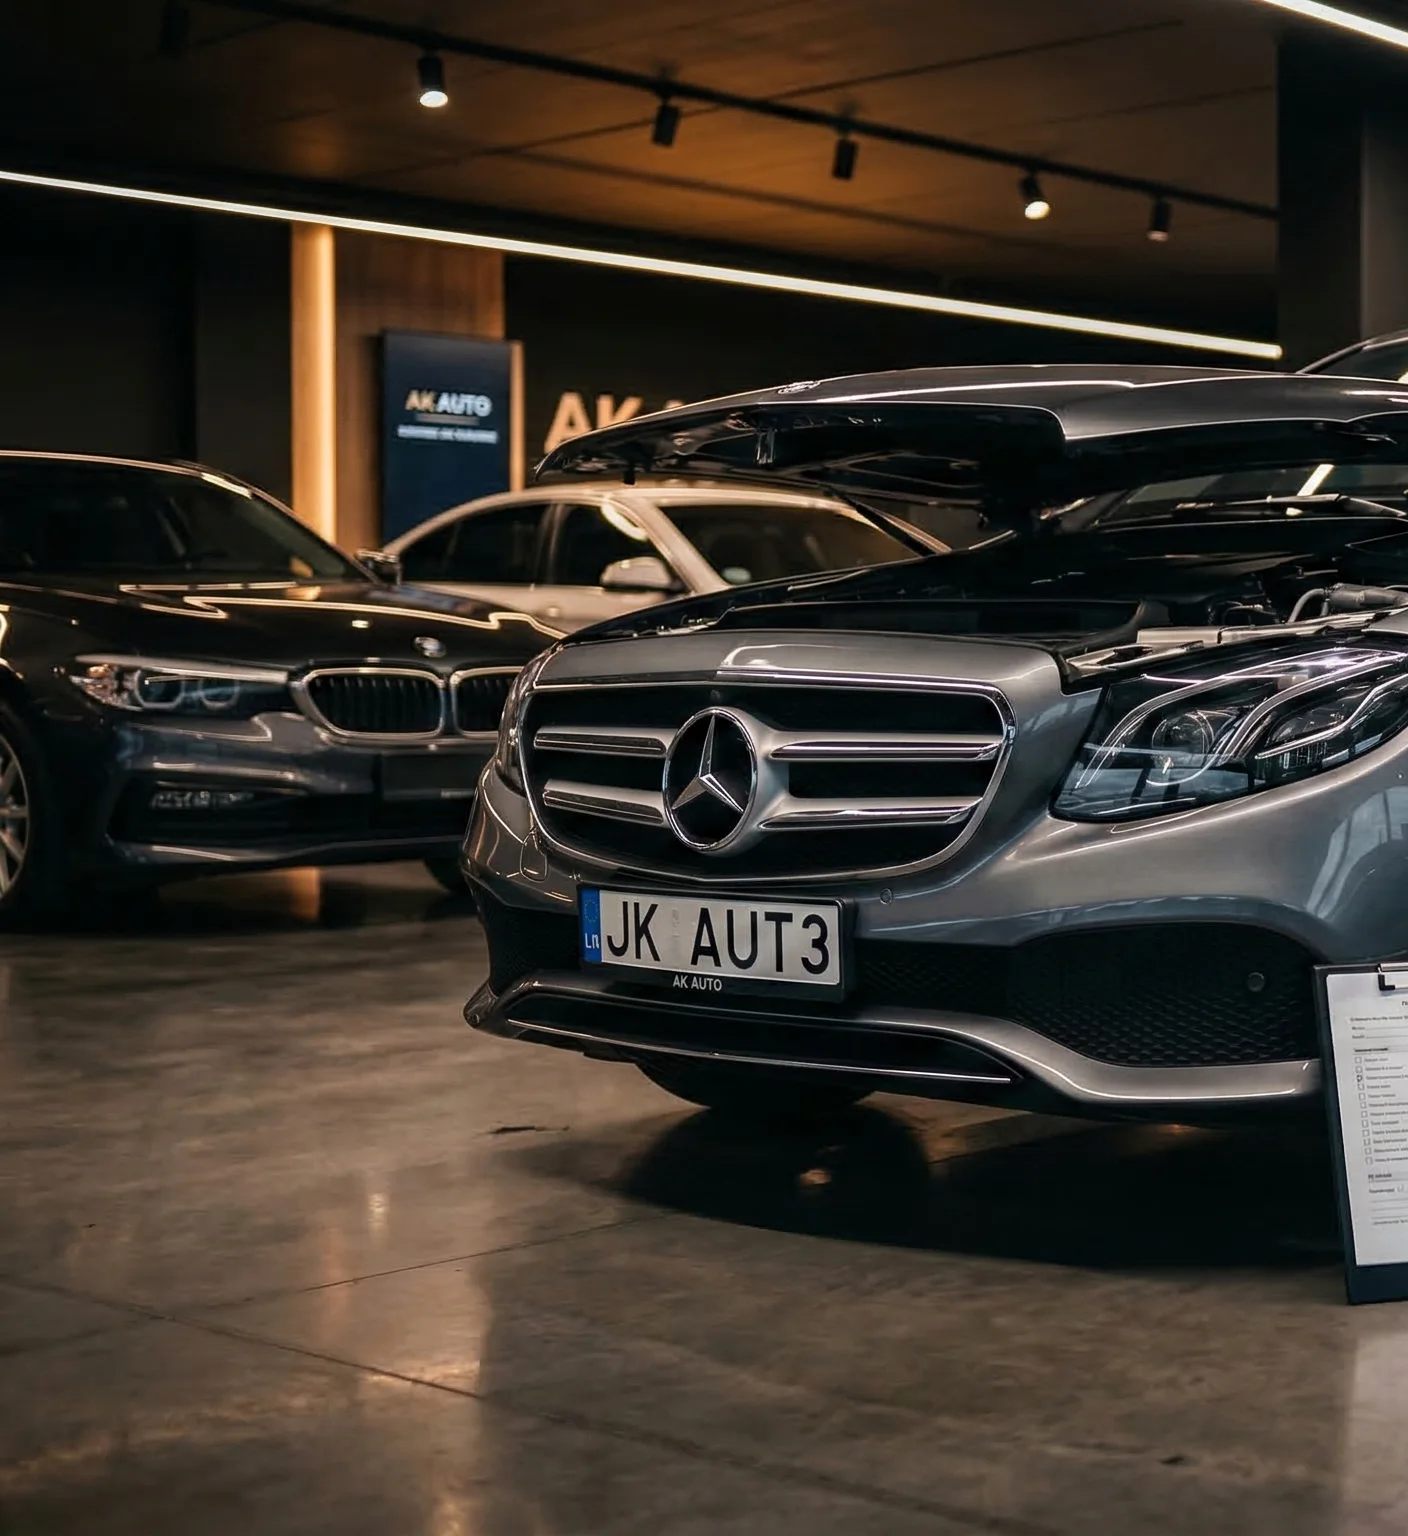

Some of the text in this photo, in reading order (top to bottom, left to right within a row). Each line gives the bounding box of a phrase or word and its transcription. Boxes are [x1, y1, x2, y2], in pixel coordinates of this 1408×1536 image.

[405, 390, 492, 417] AK AUTO
[607, 901, 830, 975] JK AUT3
[672, 974, 723, 991] AK AUTO
